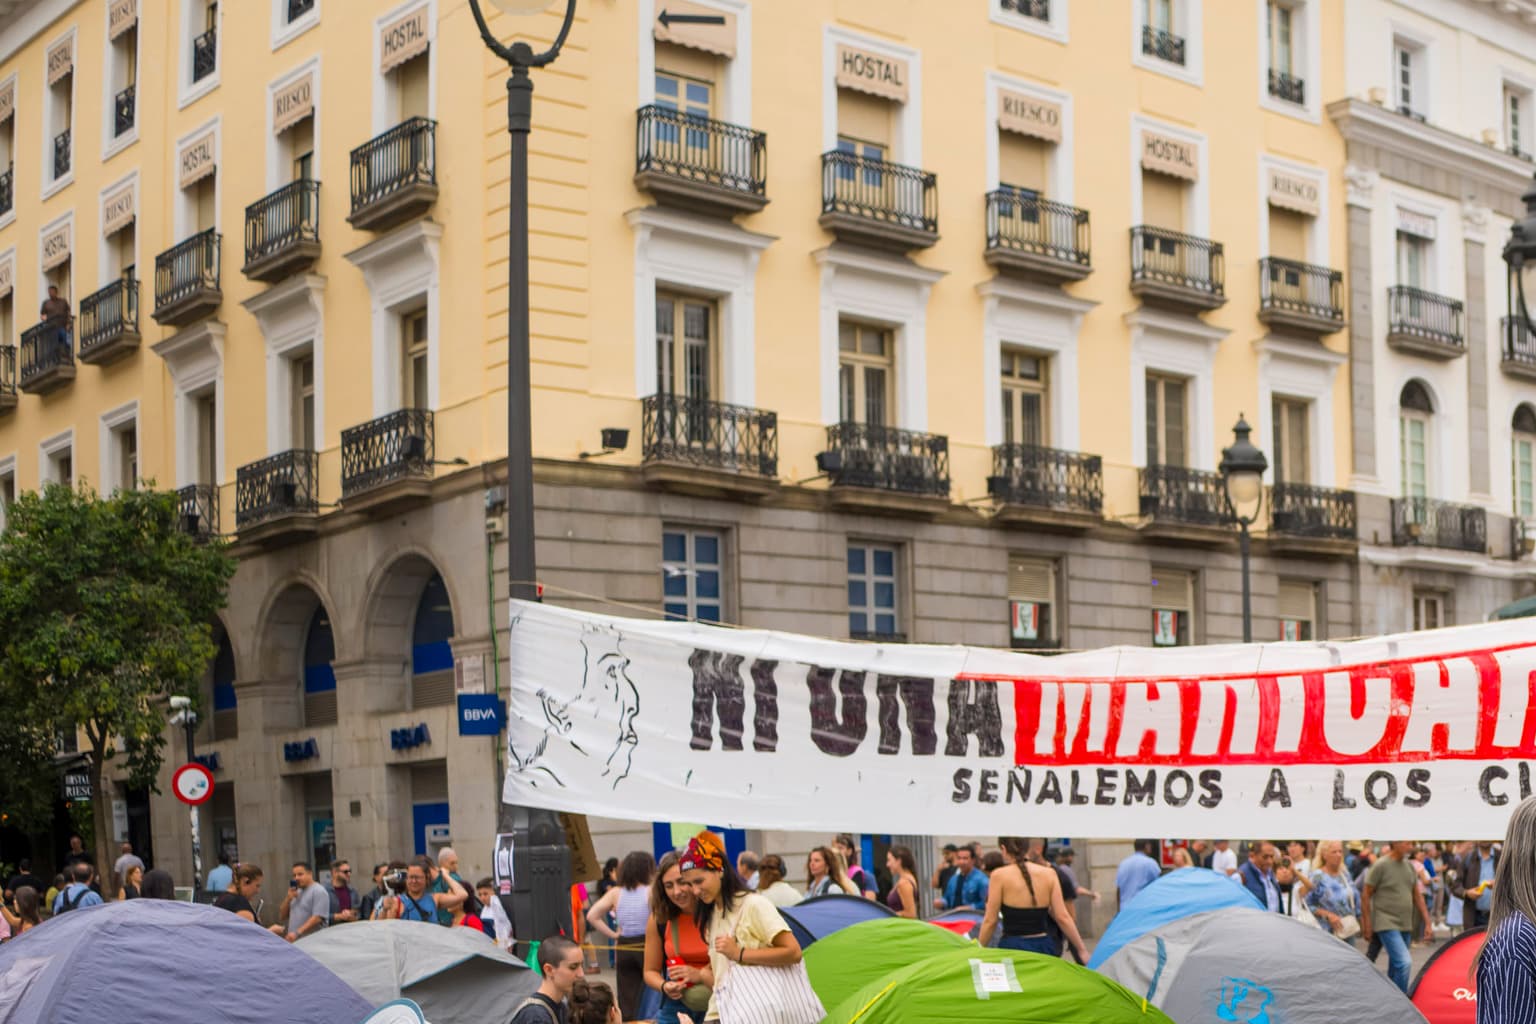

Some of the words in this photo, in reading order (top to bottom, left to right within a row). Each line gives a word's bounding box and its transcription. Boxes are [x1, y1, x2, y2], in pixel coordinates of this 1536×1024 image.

[384, 15, 424, 56] HOSTAL
[842, 51, 903, 87] HOSTAL
[276, 82, 311, 117] RIESCO
[1003, 96, 1059, 127] RIESCO
[182, 143, 211, 174] HOSTAL
[1145, 138, 1193, 168] HOSTAL
[464, 708, 497, 721] BBVA
[688, 648, 779, 752] NI
[806, 664, 1005, 757] UNA
[65, 786, 94, 798] RIESC
[952, 766, 1223, 808] SEÑALEMOS
[1260, 767, 1292, 808] A
[1331, 768, 1432, 810] LOS
[1452, 987, 1477, 1001] Qu
